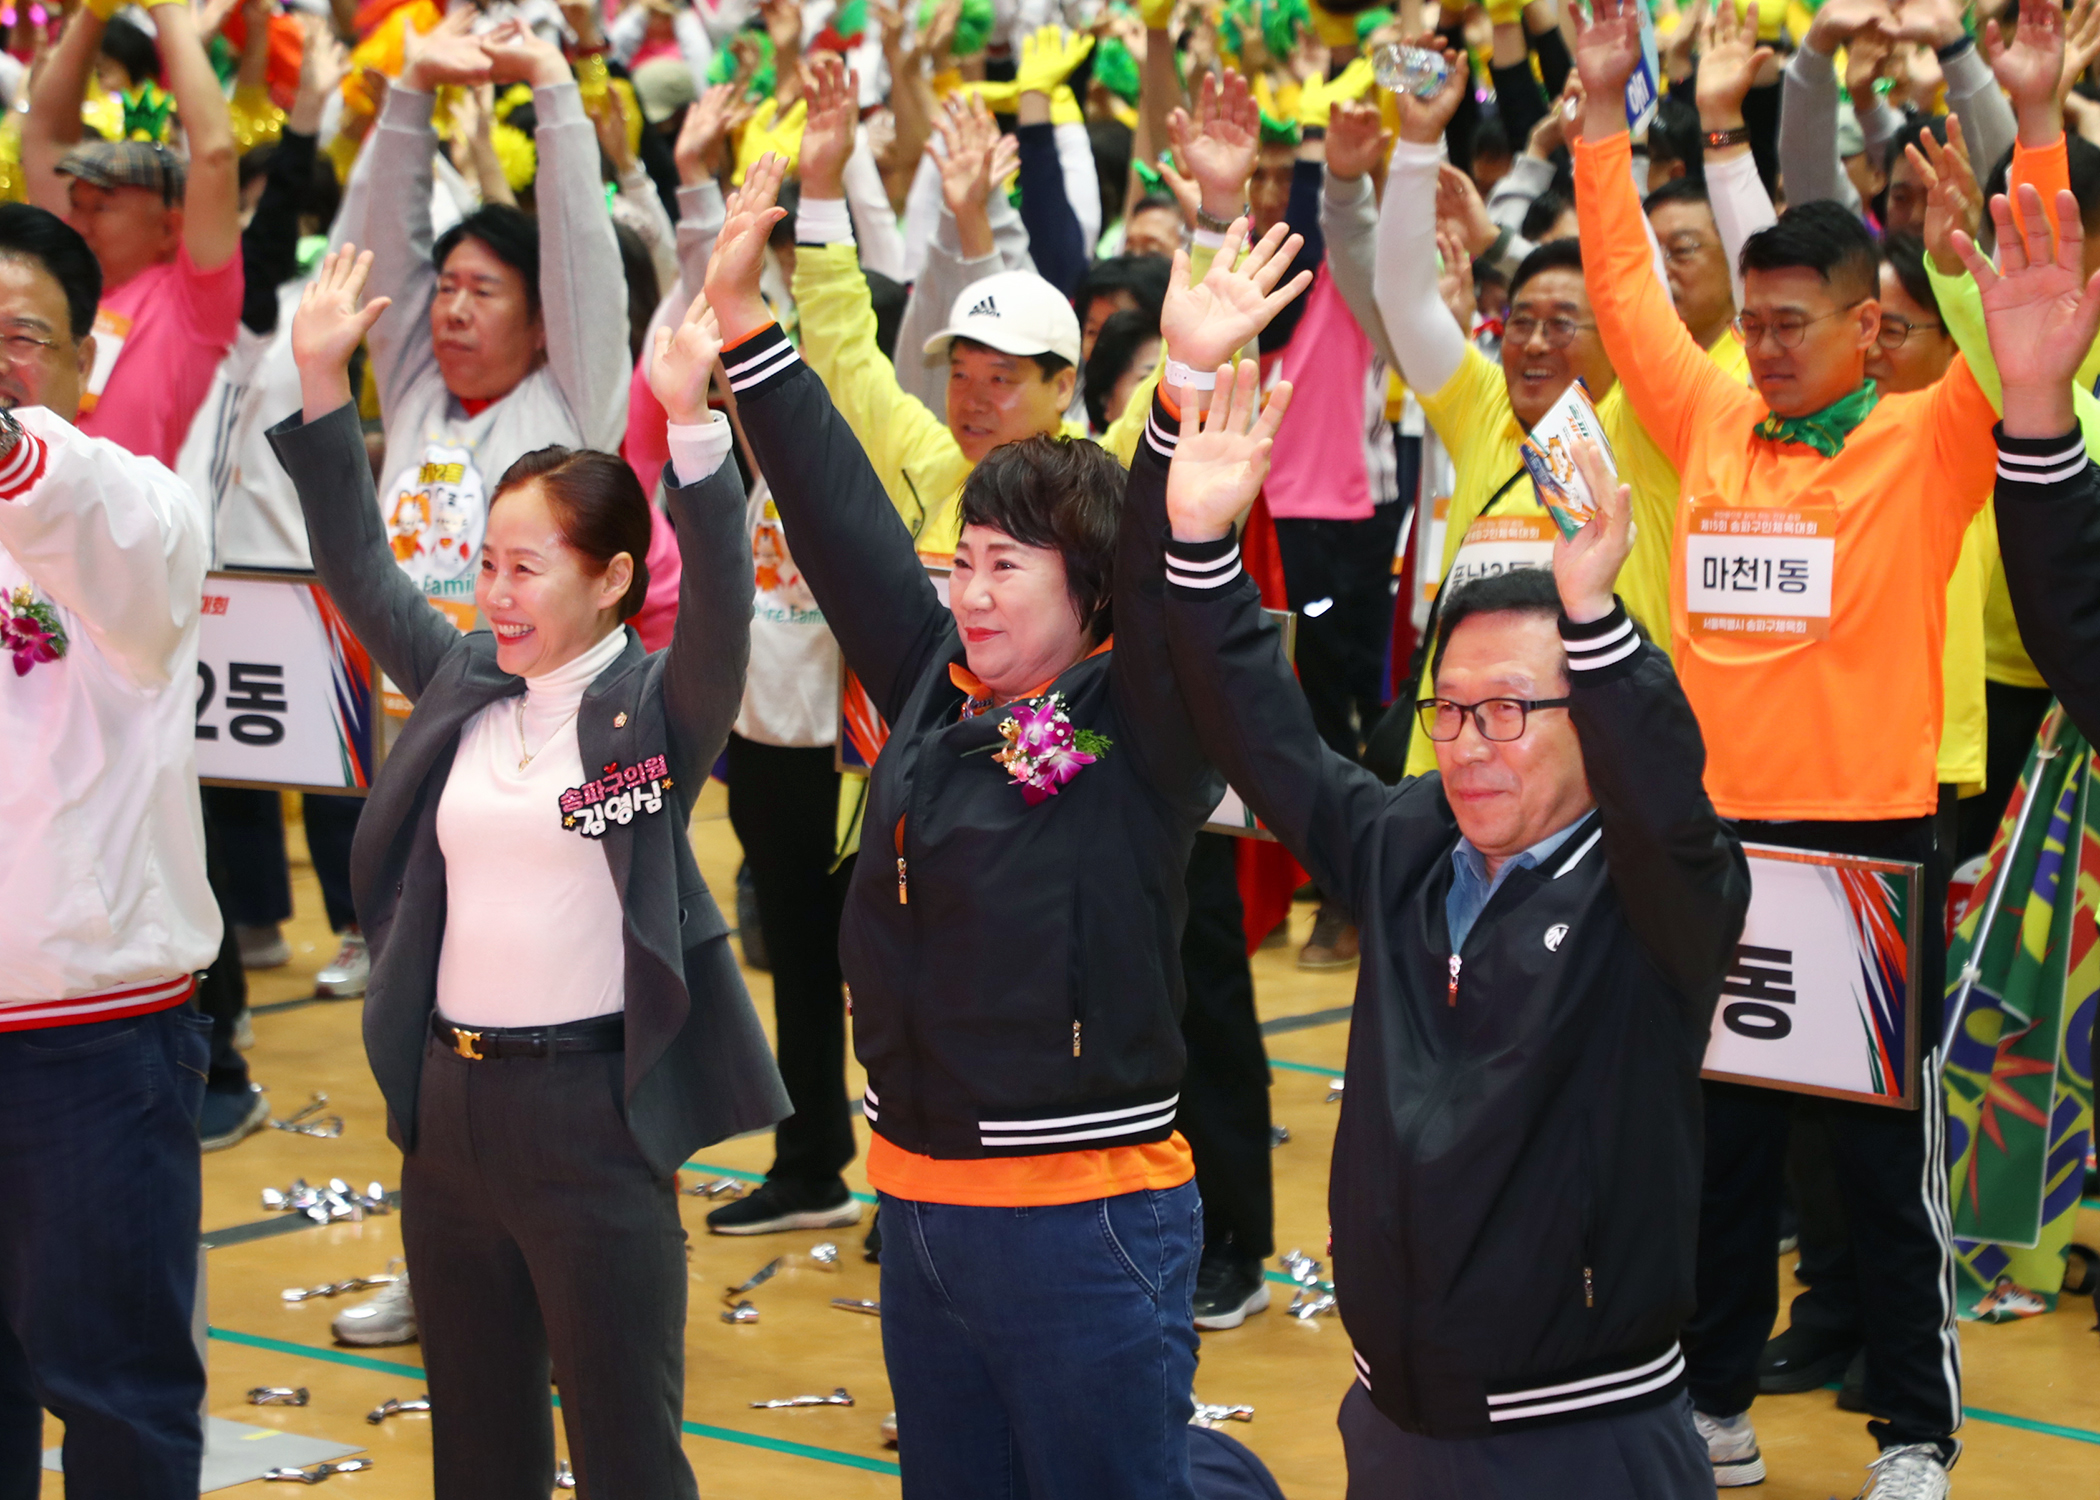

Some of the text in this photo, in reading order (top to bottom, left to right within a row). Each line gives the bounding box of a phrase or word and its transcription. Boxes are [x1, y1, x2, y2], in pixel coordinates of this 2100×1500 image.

[1700, 519, 1818, 535] 제15회 송파구민체육대회
[1703, 556, 1809, 593] 마천1동
[1746, 620, 1807, 634] 송파구체육회
[559, 753, 669, 813] 송파구의원
[573, 780, 662, 836] 김영심
[1719, 943, 1797, 1041] 동
